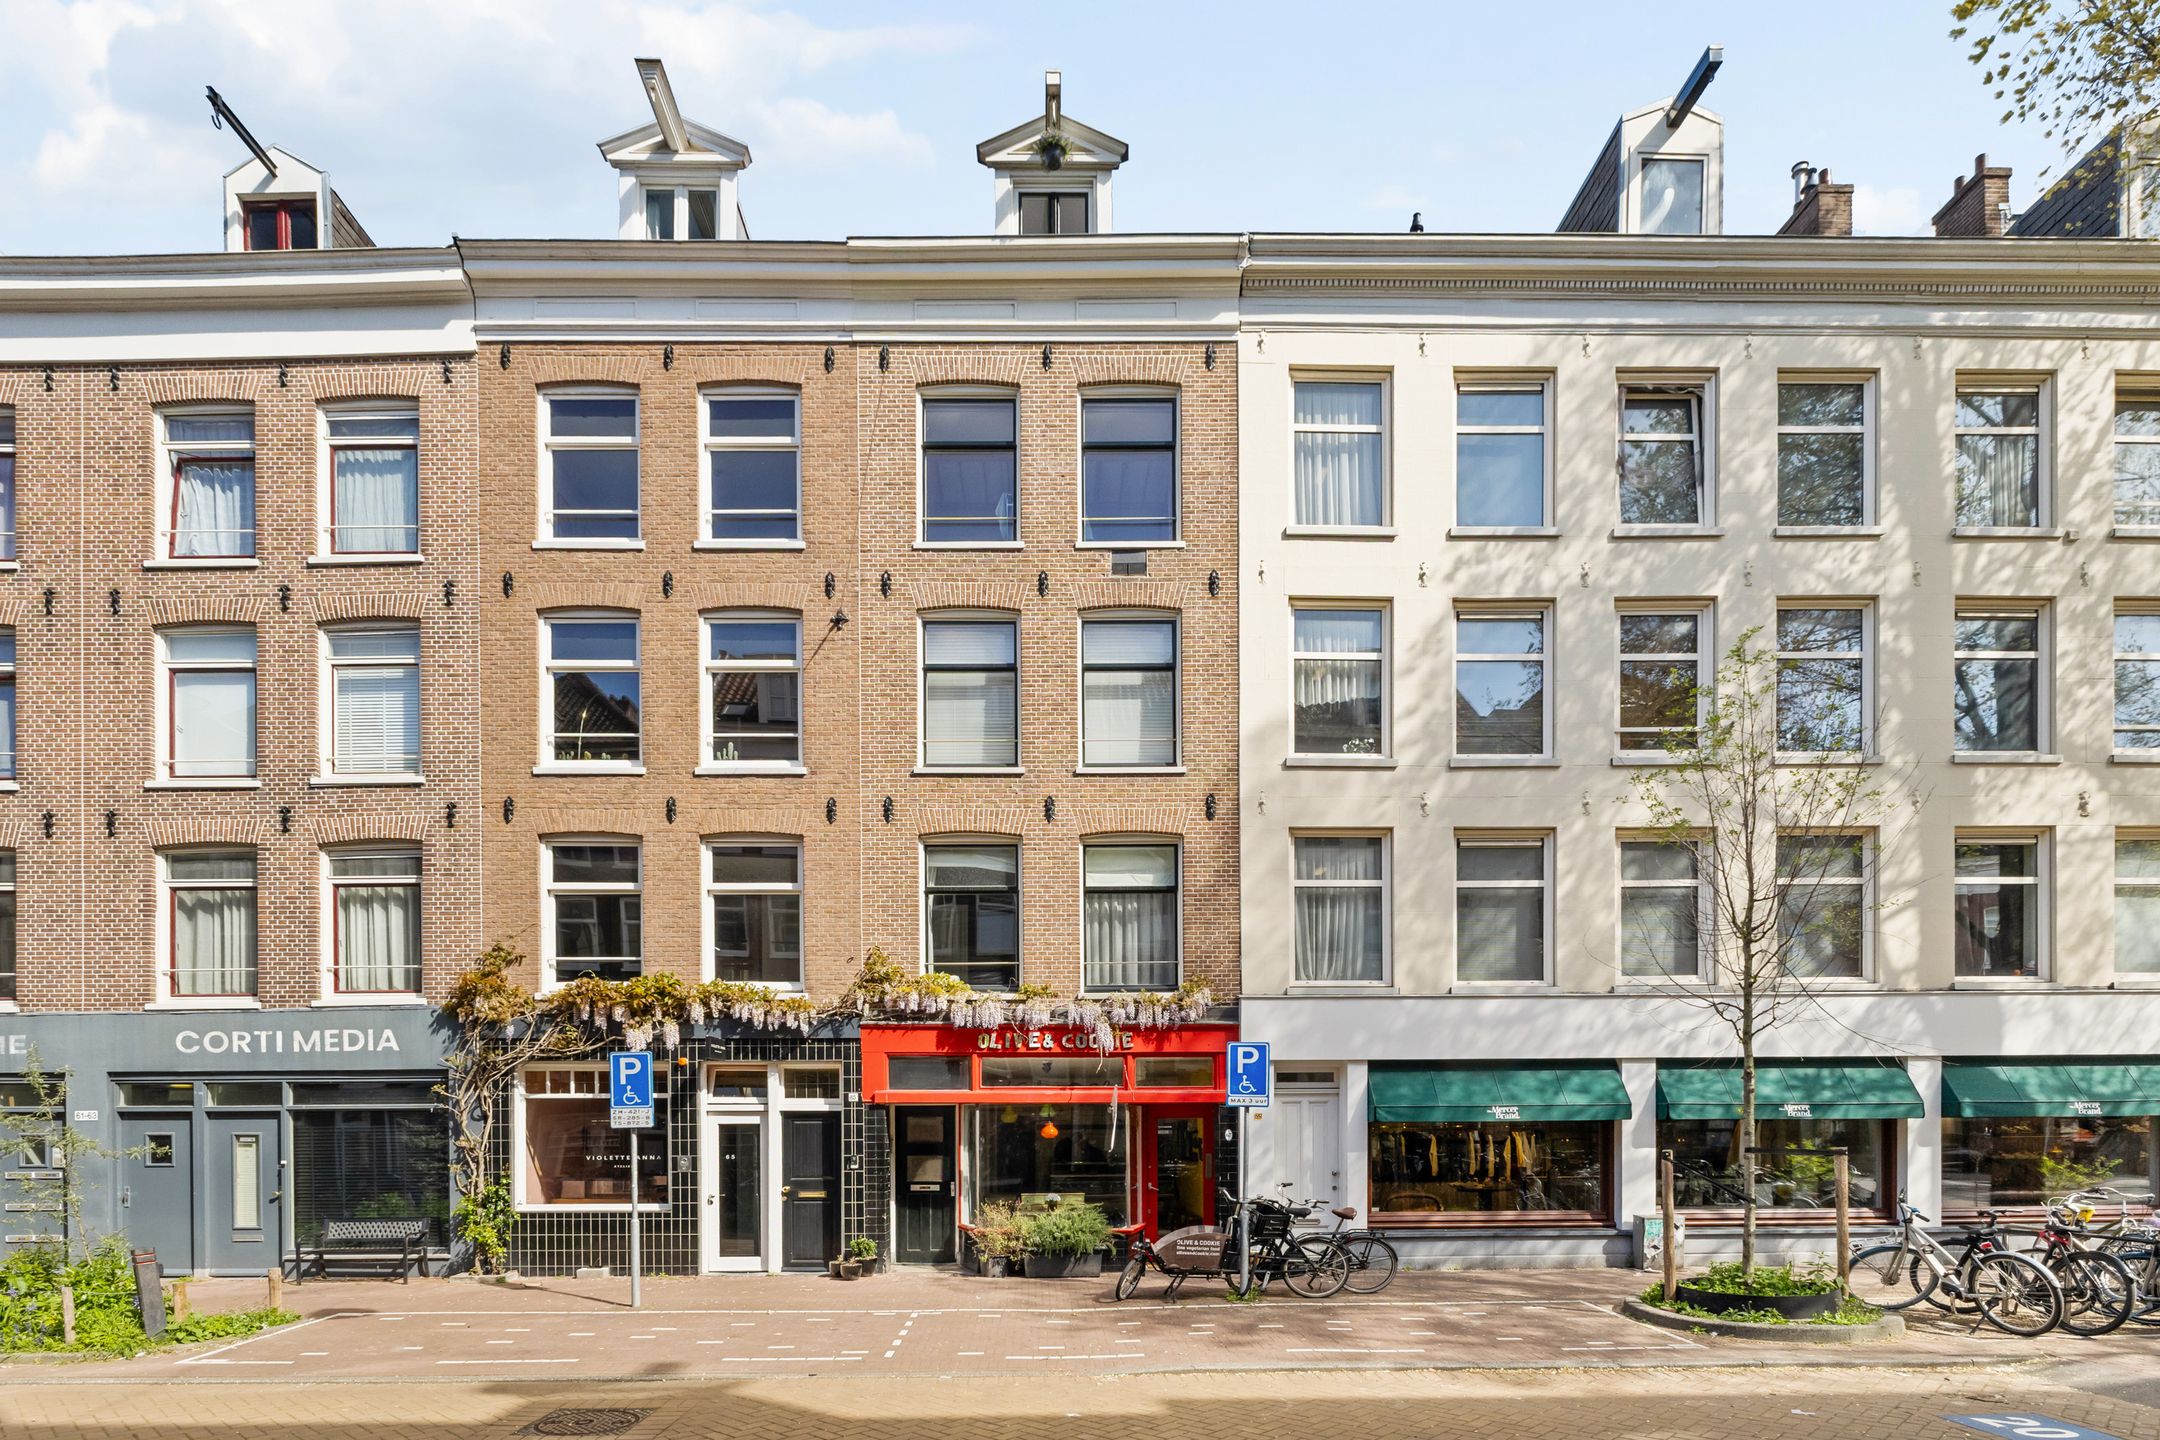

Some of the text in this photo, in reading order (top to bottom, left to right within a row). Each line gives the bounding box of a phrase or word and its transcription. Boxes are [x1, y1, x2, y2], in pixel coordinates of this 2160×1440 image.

[0, 1034, 27, 1055] E
[175, 1028, 401, 1054] CORTI MEDIA
[1061, 1031, 1134, 1049] COOIE
[619, 1057, 641, 1085] P
[1237, 1046, 1259, 1073] P
